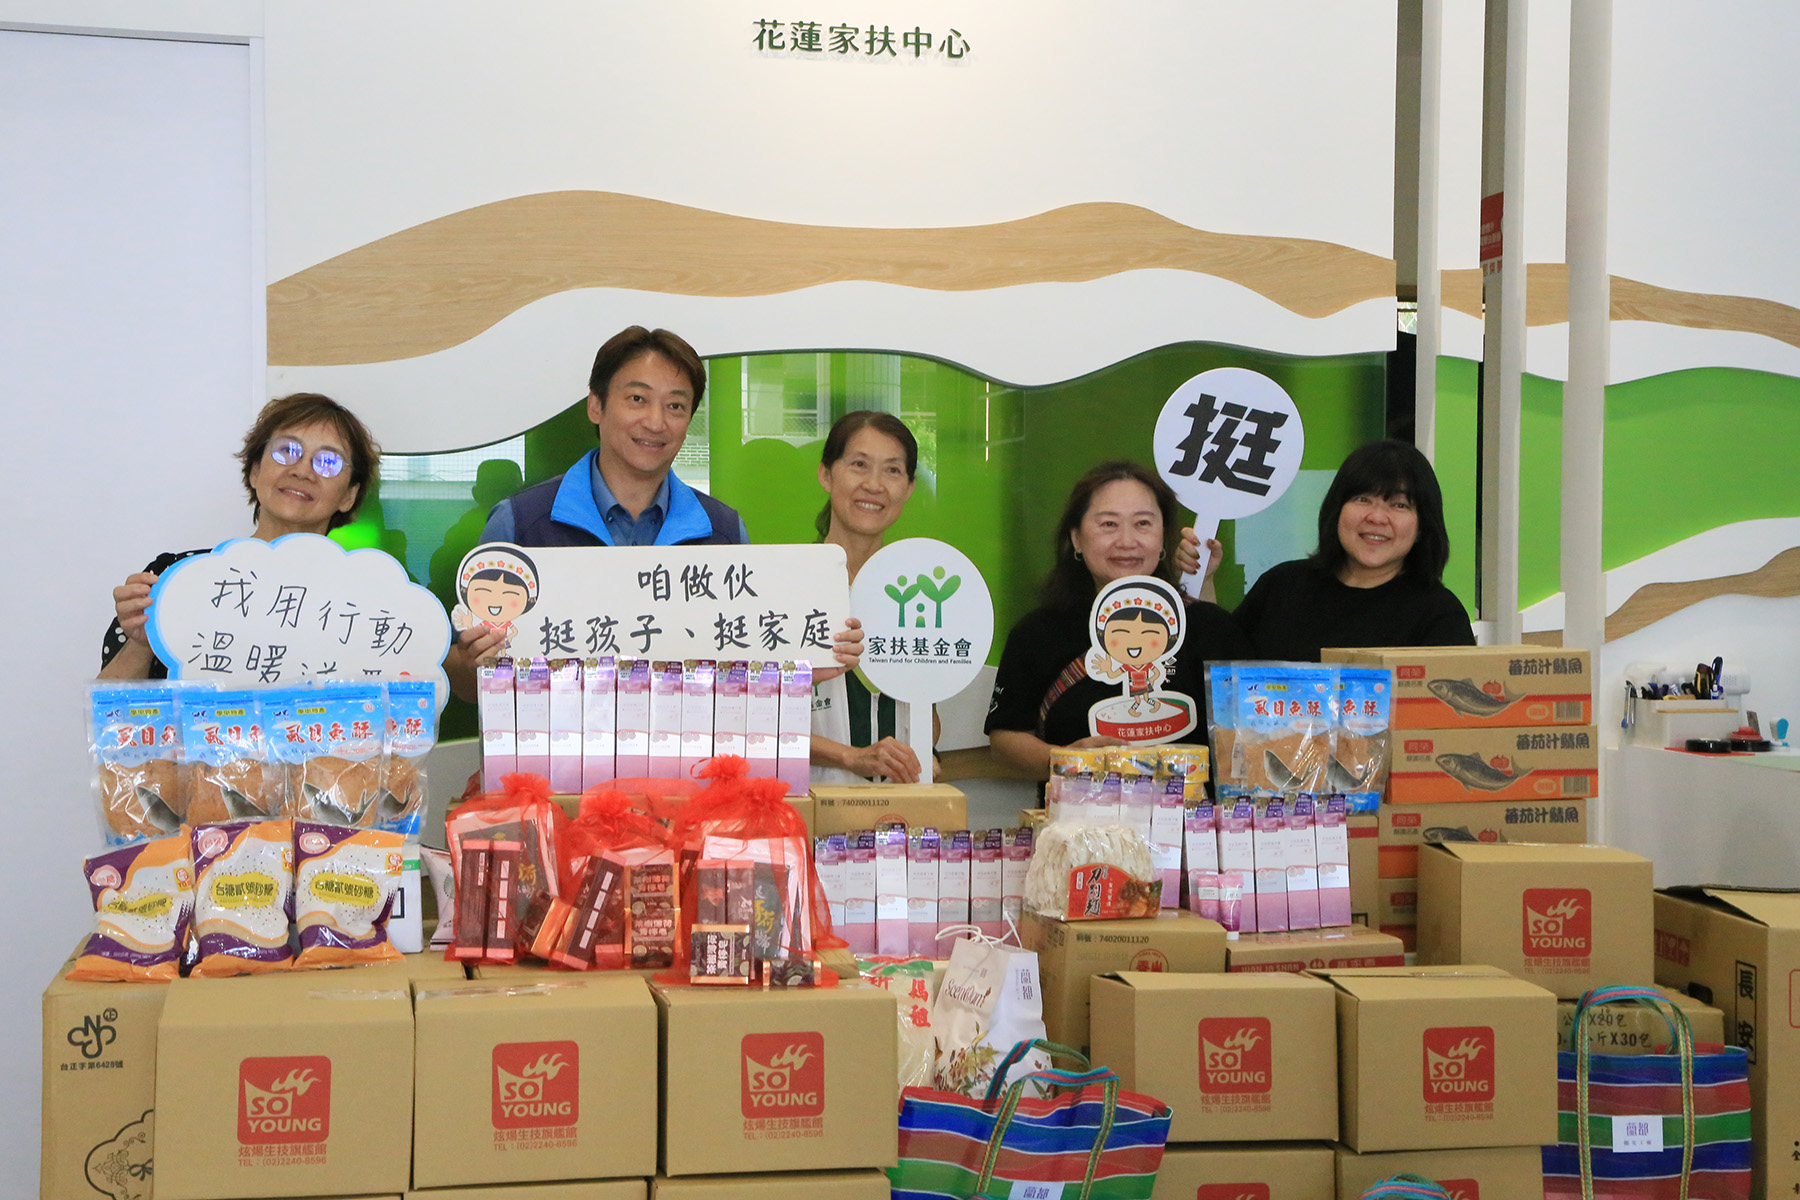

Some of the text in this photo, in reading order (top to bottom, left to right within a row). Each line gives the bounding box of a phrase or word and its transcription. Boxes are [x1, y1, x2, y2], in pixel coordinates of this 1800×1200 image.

[753, 18, 971, 58] 花蓮家扶中心
[1168, 393, 1289, 497] 挺
[637, 563, 759, 601] 咱做伙
[211, 567, 413, 657] 我用行動
[539, 608, 834, 655] 挺孩子、挺家庭
[868, 636, 972, 657] 家扶基金會
[188, 630, 382, 684] 溫暖
[914, 657, 937, 665] Children
[1508, 658, 1583, 675] 蕃茄汁鯖魚
[1253, 699, 1323, 718] 虱目魚酥
[1341, 698, 1380, 717] 魚酥
[285, 720, 375, 744] 虱目魚酥
[1117, 723, 1173, 738] 花蓮家扶中心
[1516, 733, 1590, 750] 蕃茄汁鯖魚
[215, 881, 274, 898] 台糖貳號砂糖
[1532, 919, 1560, 934] SO
[1099, 934, 1150, 944] 74020011120
[1530, 937, 1586, 949] YOUNG
[1208, 1051, 1239, 1068] SO
[1207, 1071, 1266, 1084] YOUNG
[1432, 1061, 1463, 1078] SO
[752, 1071, 788, 1090] SO
[1431, 1080, 1489, 1093] YOUNG
[504, 1081, 540, 1100] SO
[250, 1096, 289, 1116] SO
[750, 1092, 818, 1107] YOUNG
[501, 1101, 571, 1118] YOUNG
[247, 1117, 322, 1133] YOUNG
